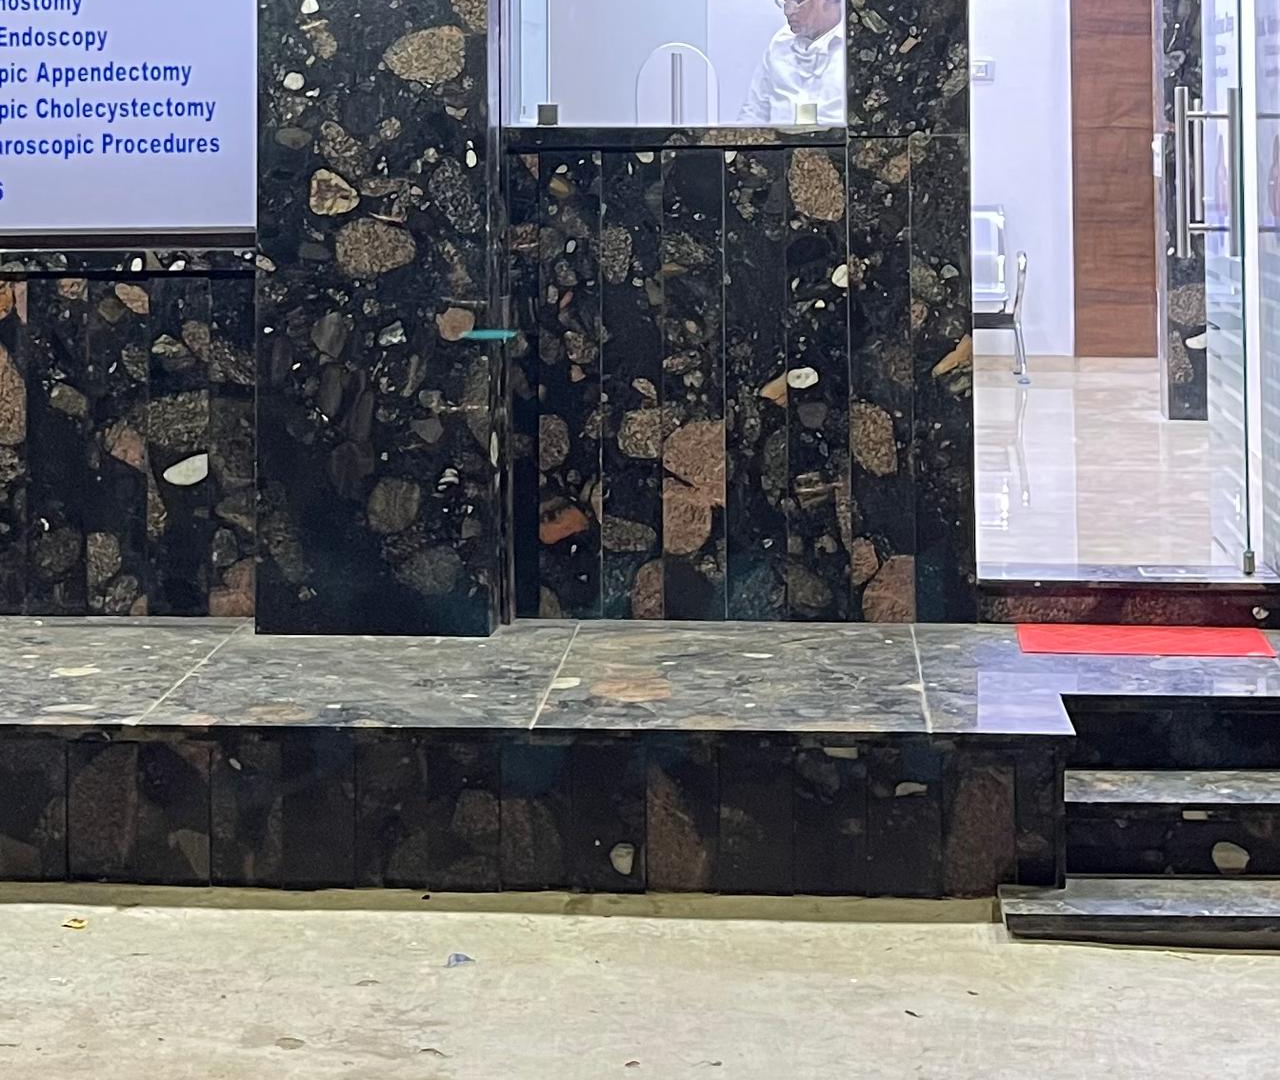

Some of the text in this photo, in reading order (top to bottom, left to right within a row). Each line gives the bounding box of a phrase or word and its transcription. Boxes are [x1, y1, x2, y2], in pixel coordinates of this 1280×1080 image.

[37, 61, 191, 87] Appendectomy
[36, 98, 216, 123] Cholecystectomy
[103, 133, 219, 153] Procedures
